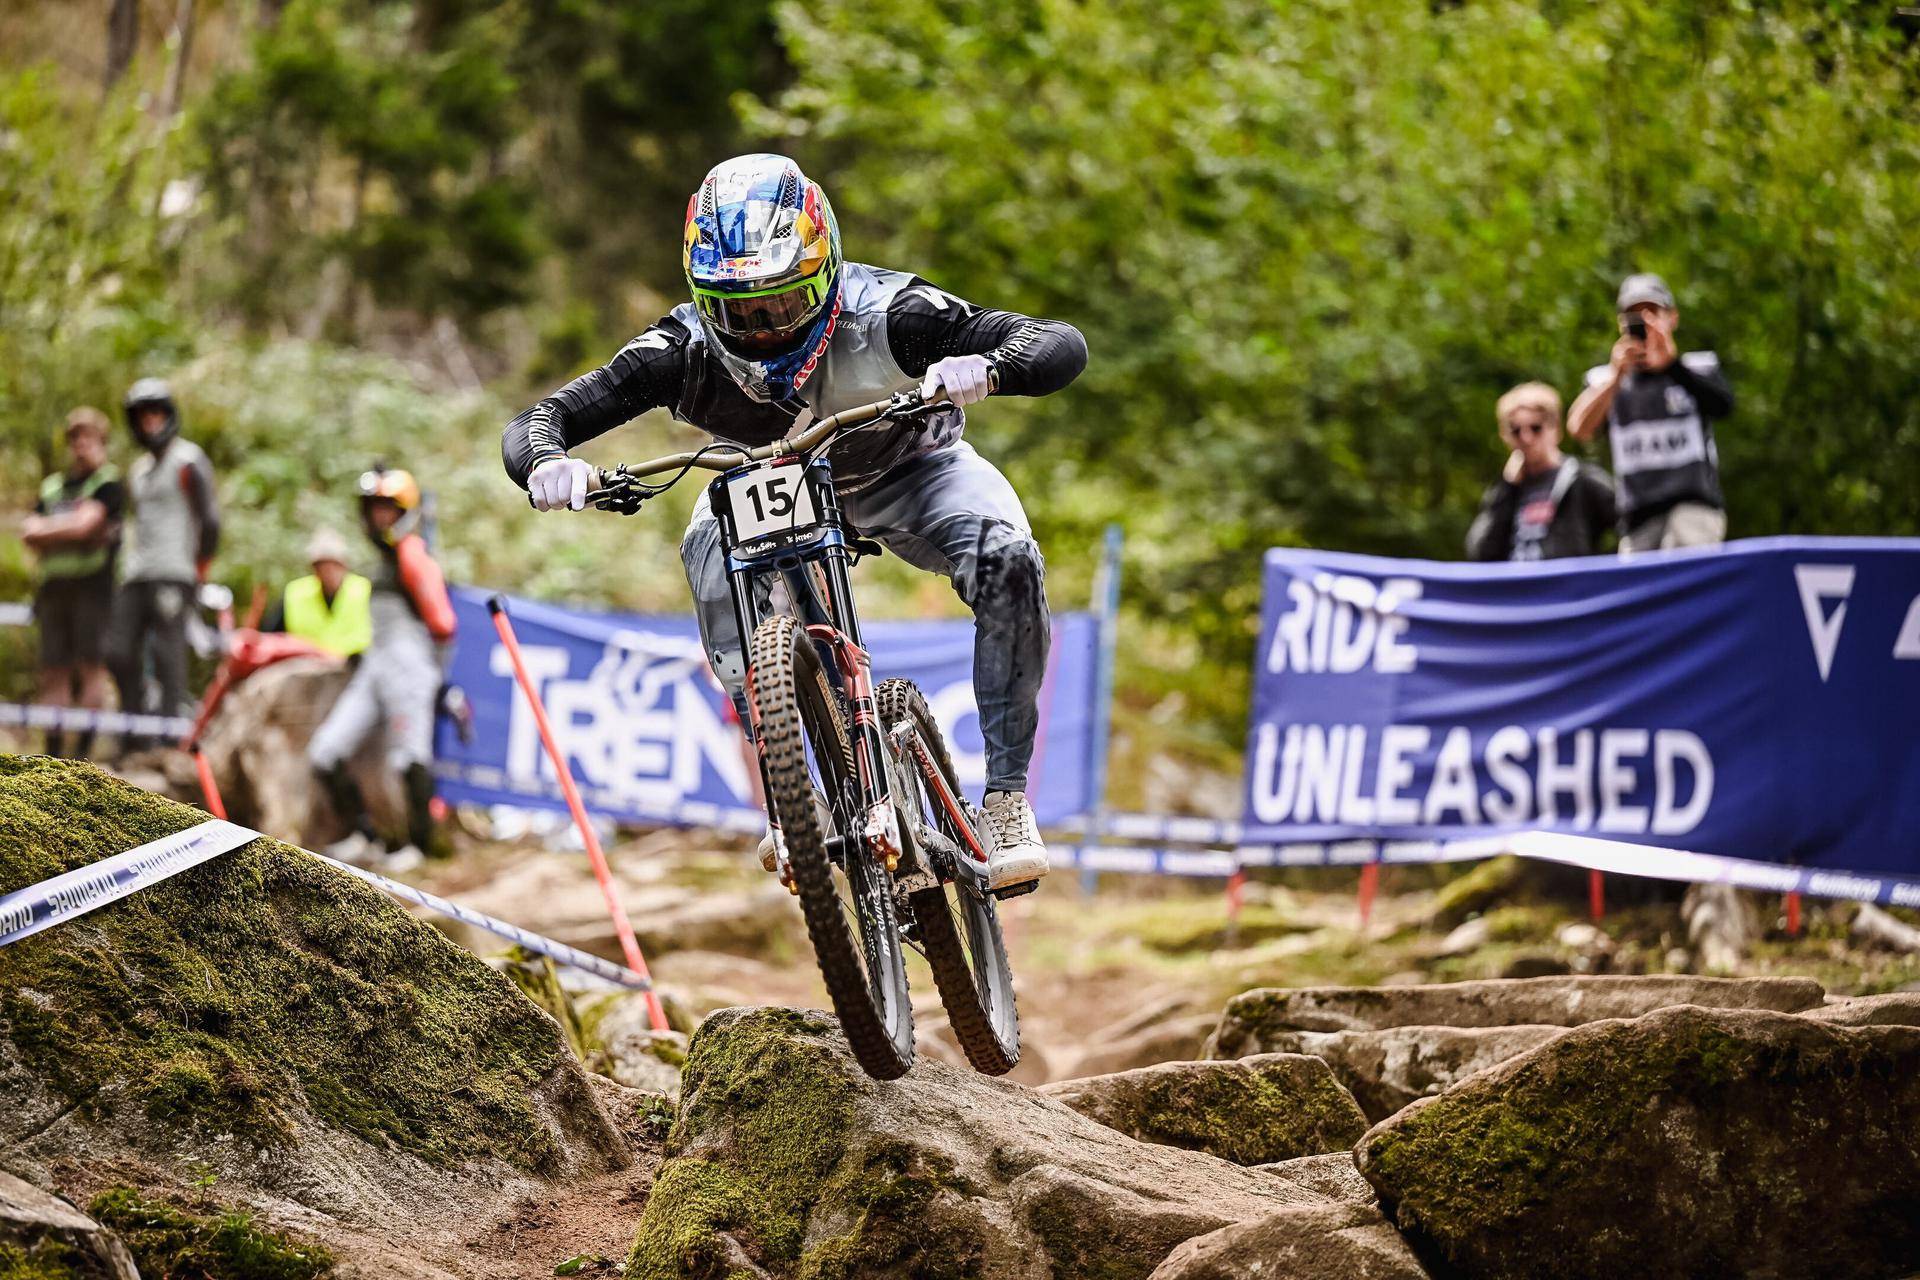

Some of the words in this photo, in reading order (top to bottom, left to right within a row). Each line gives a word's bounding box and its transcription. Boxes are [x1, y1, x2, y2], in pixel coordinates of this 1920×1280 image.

[745, 477, 794, 523] 15
[1267, 572, 1424, 674] RIDE
[1250, 722, 1715, 837] UNLEASHED
[46, 869, 120, 918] SHIMANO
[873, 893, 886, 932] SWIS
[877, 863, 895, 927] ANNIBAL
[880, 933, 892, 958] DT
